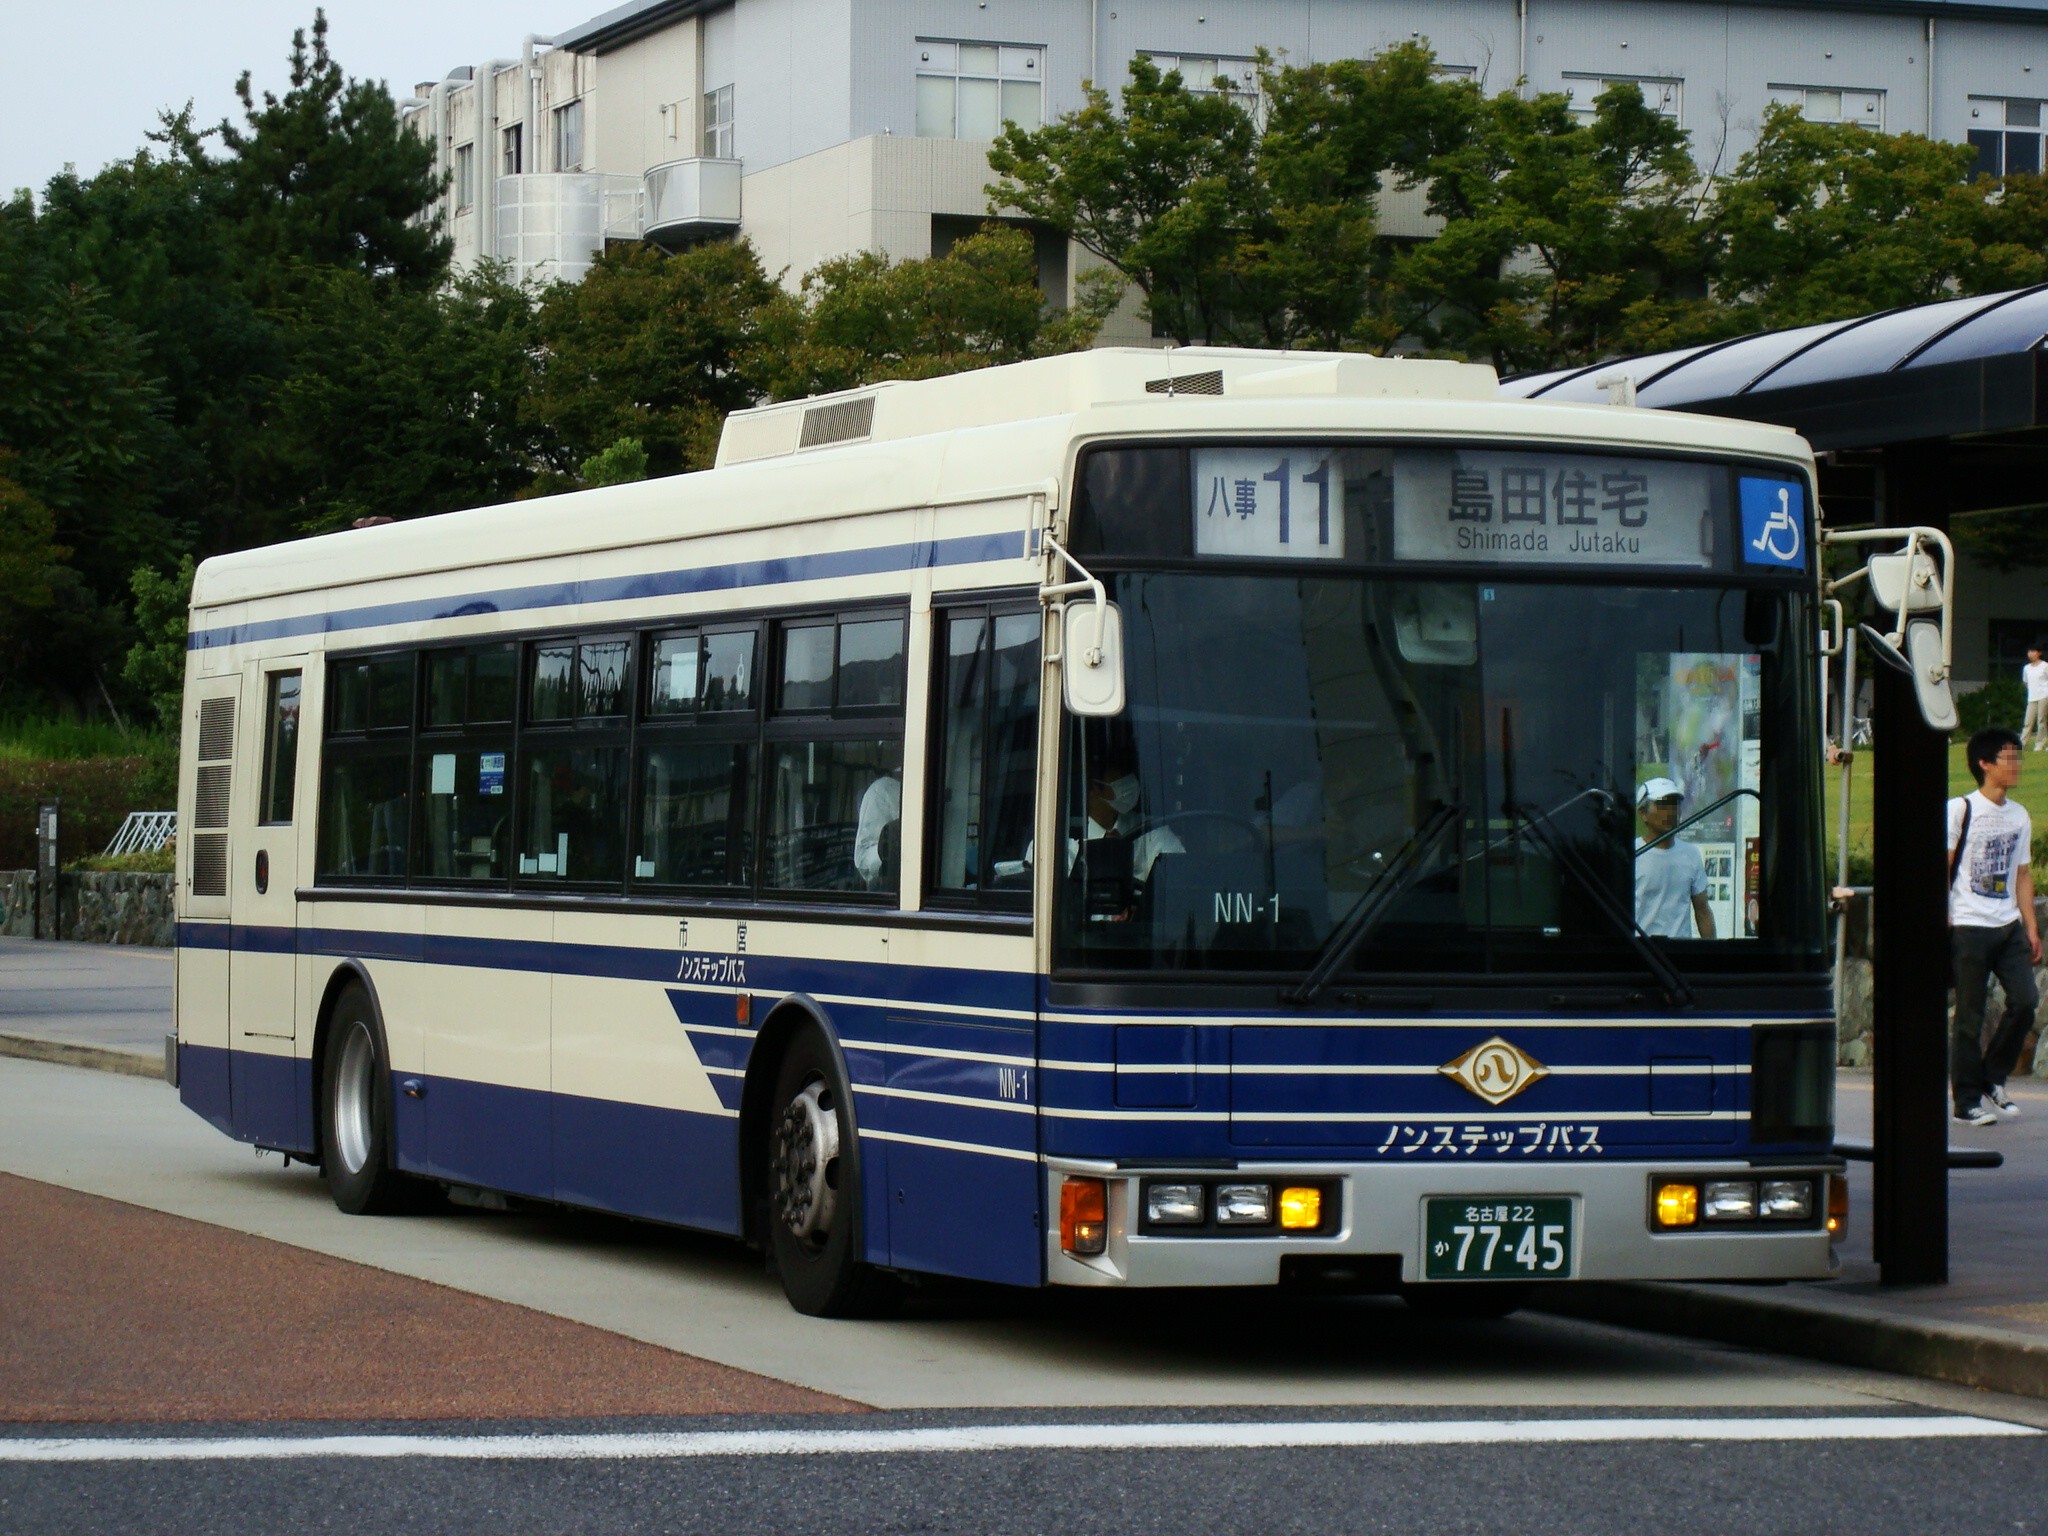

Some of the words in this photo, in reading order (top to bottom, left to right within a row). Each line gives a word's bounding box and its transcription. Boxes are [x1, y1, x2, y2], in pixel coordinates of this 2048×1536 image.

[1208, 476, 1257, 521] 八事
[1263, 458, 1329, 545] 11
[1448, 467, 1649, 528] 島田住宅
[1457, 526, 1549, 552] Shimada
[1569, 530, 1640, 554] Jutaku
[1215, 892, 1279, 923] NN-1
[677, 956, 746, 983] ノンステップバス
[1377, 1123, 1603, 1154] ノンステップバス
[1464, 1206, 1509, 1223] 名古屋
[1512, 1206, 1535, 1222] 22
[1453, 1225, 1565, 1271] 77-45
